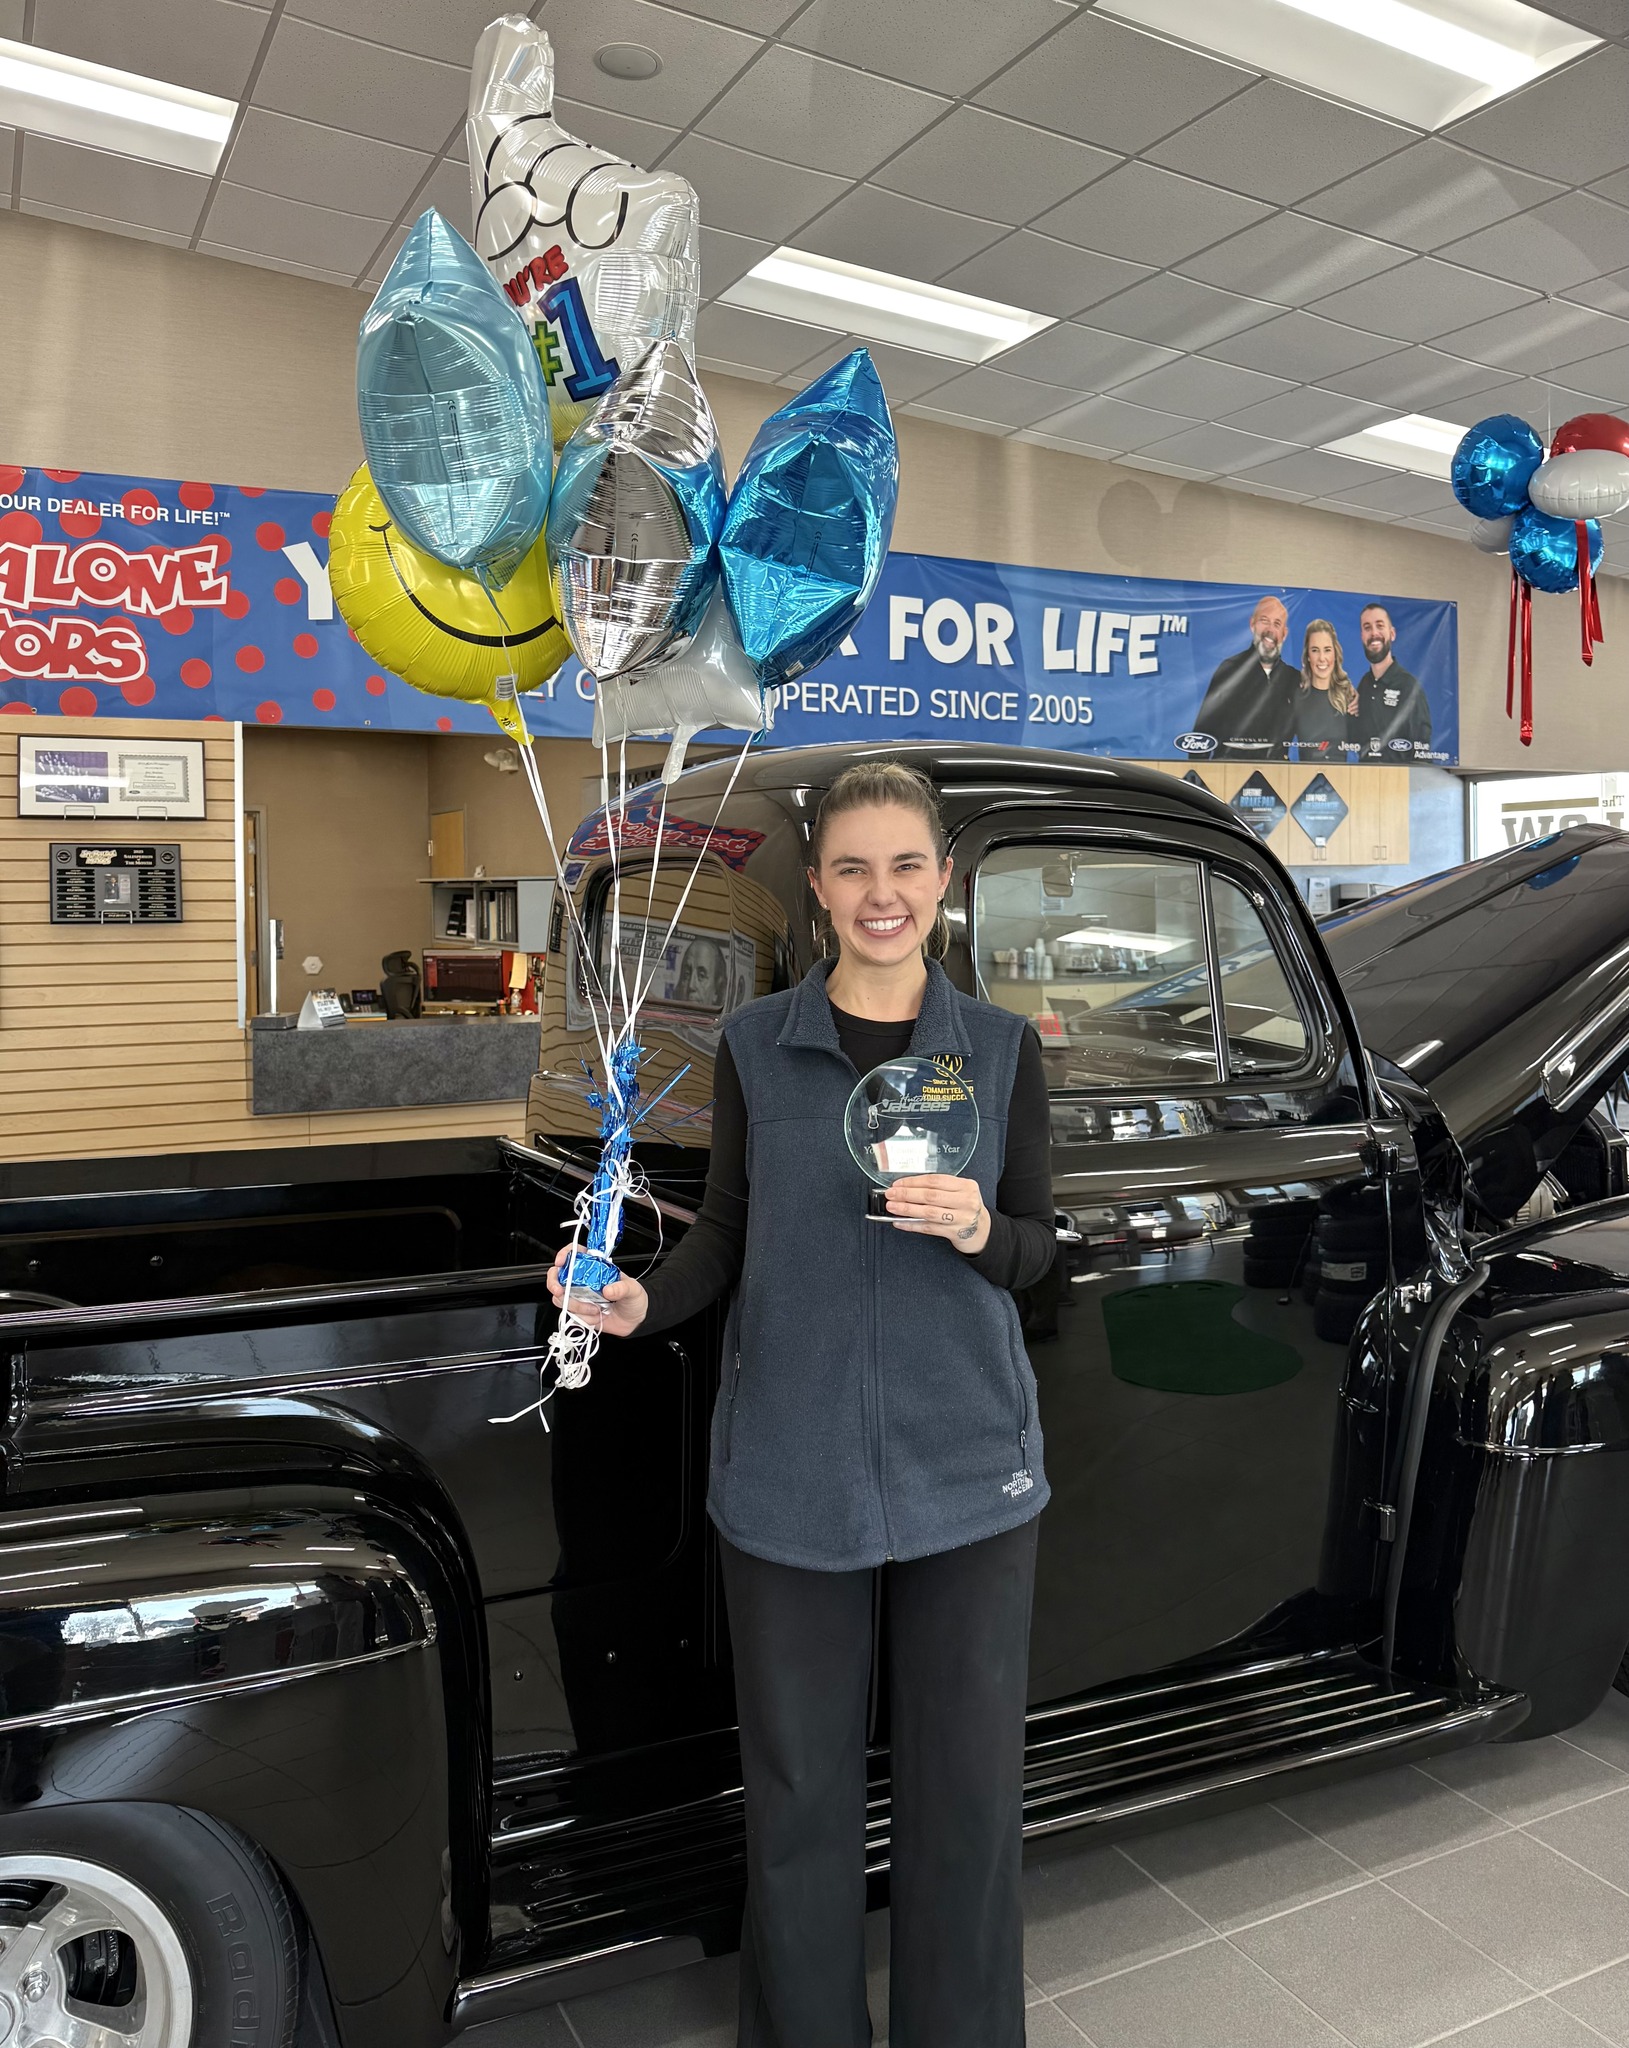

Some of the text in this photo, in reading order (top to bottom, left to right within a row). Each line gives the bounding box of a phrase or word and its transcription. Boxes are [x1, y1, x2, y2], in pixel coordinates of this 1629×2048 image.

[48, 498, 125, 518] DEALER
[131, 505, 169, 521] FOR
[889, 594, 1015, 666] FOR
[0, 608, 147, 683] ORS
[930, 687, 1019, 721] SINCE
[1028, 693, 1094, 725] 2005
[1282, 741, 1320, 749] DODGE
[1338, 740, 1361, 753] Jeep
[1413, 741, 1430, 751] Blue
[1413, 750, 1450, 762] Advantage
[881, 1102, 951, 1113] Jaycees
[943, 1144, 960, 1153] Year
[1002, 1477, 1025, 1494] NORTH
[1011, 1484, 1026, 1498] FACE
[206, 1892, 262, 2048] Rad
